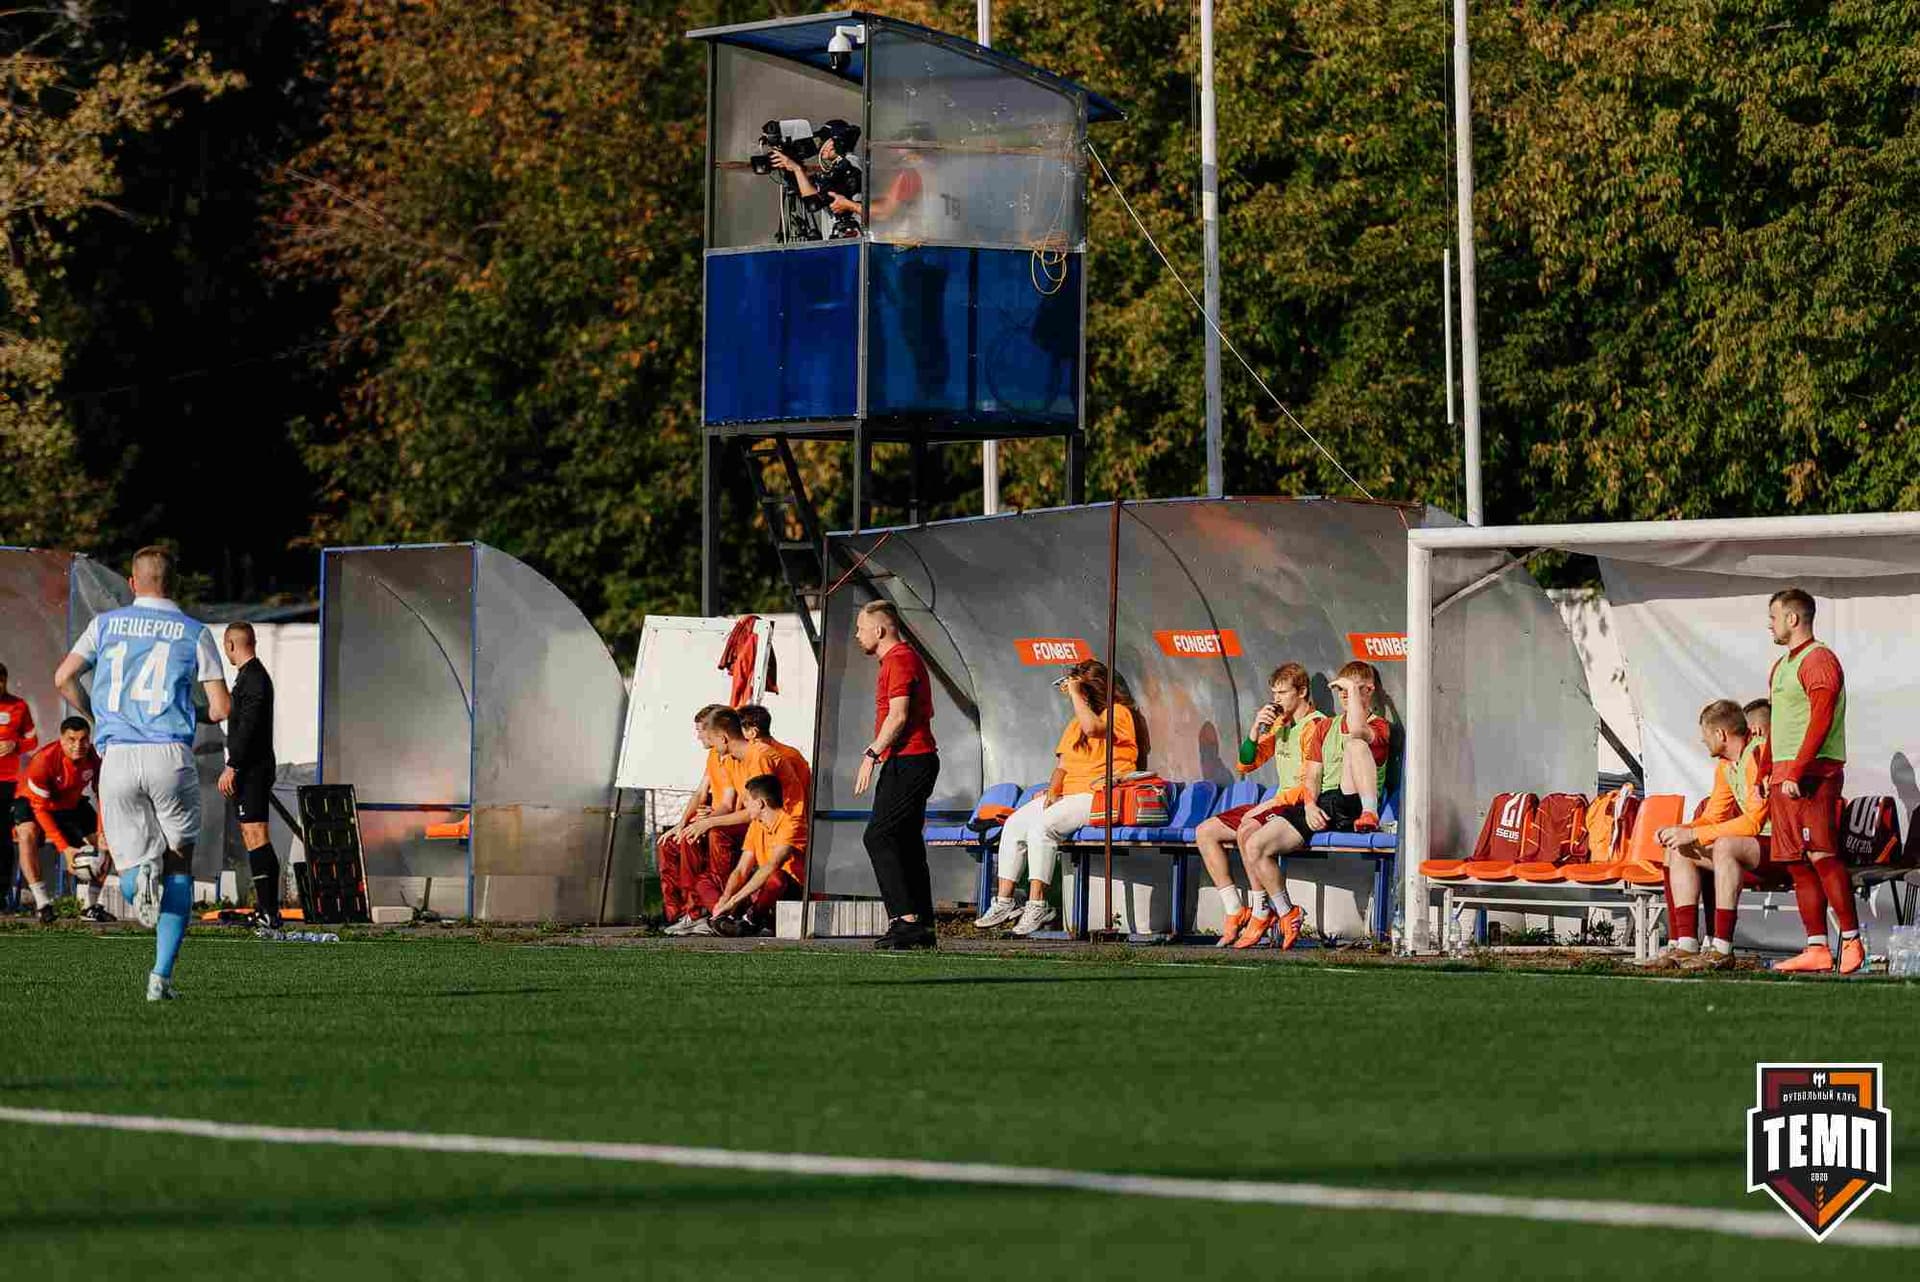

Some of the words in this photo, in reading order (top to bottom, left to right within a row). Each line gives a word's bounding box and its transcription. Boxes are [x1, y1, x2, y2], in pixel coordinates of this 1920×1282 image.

[107, 617, 184, 640] ПЕЩЕРОВ
[1032, 642, 1078, 660] FONBET
[1173, 634, 1221, 653] FONBET
[104, 641, 170, 715] 14
